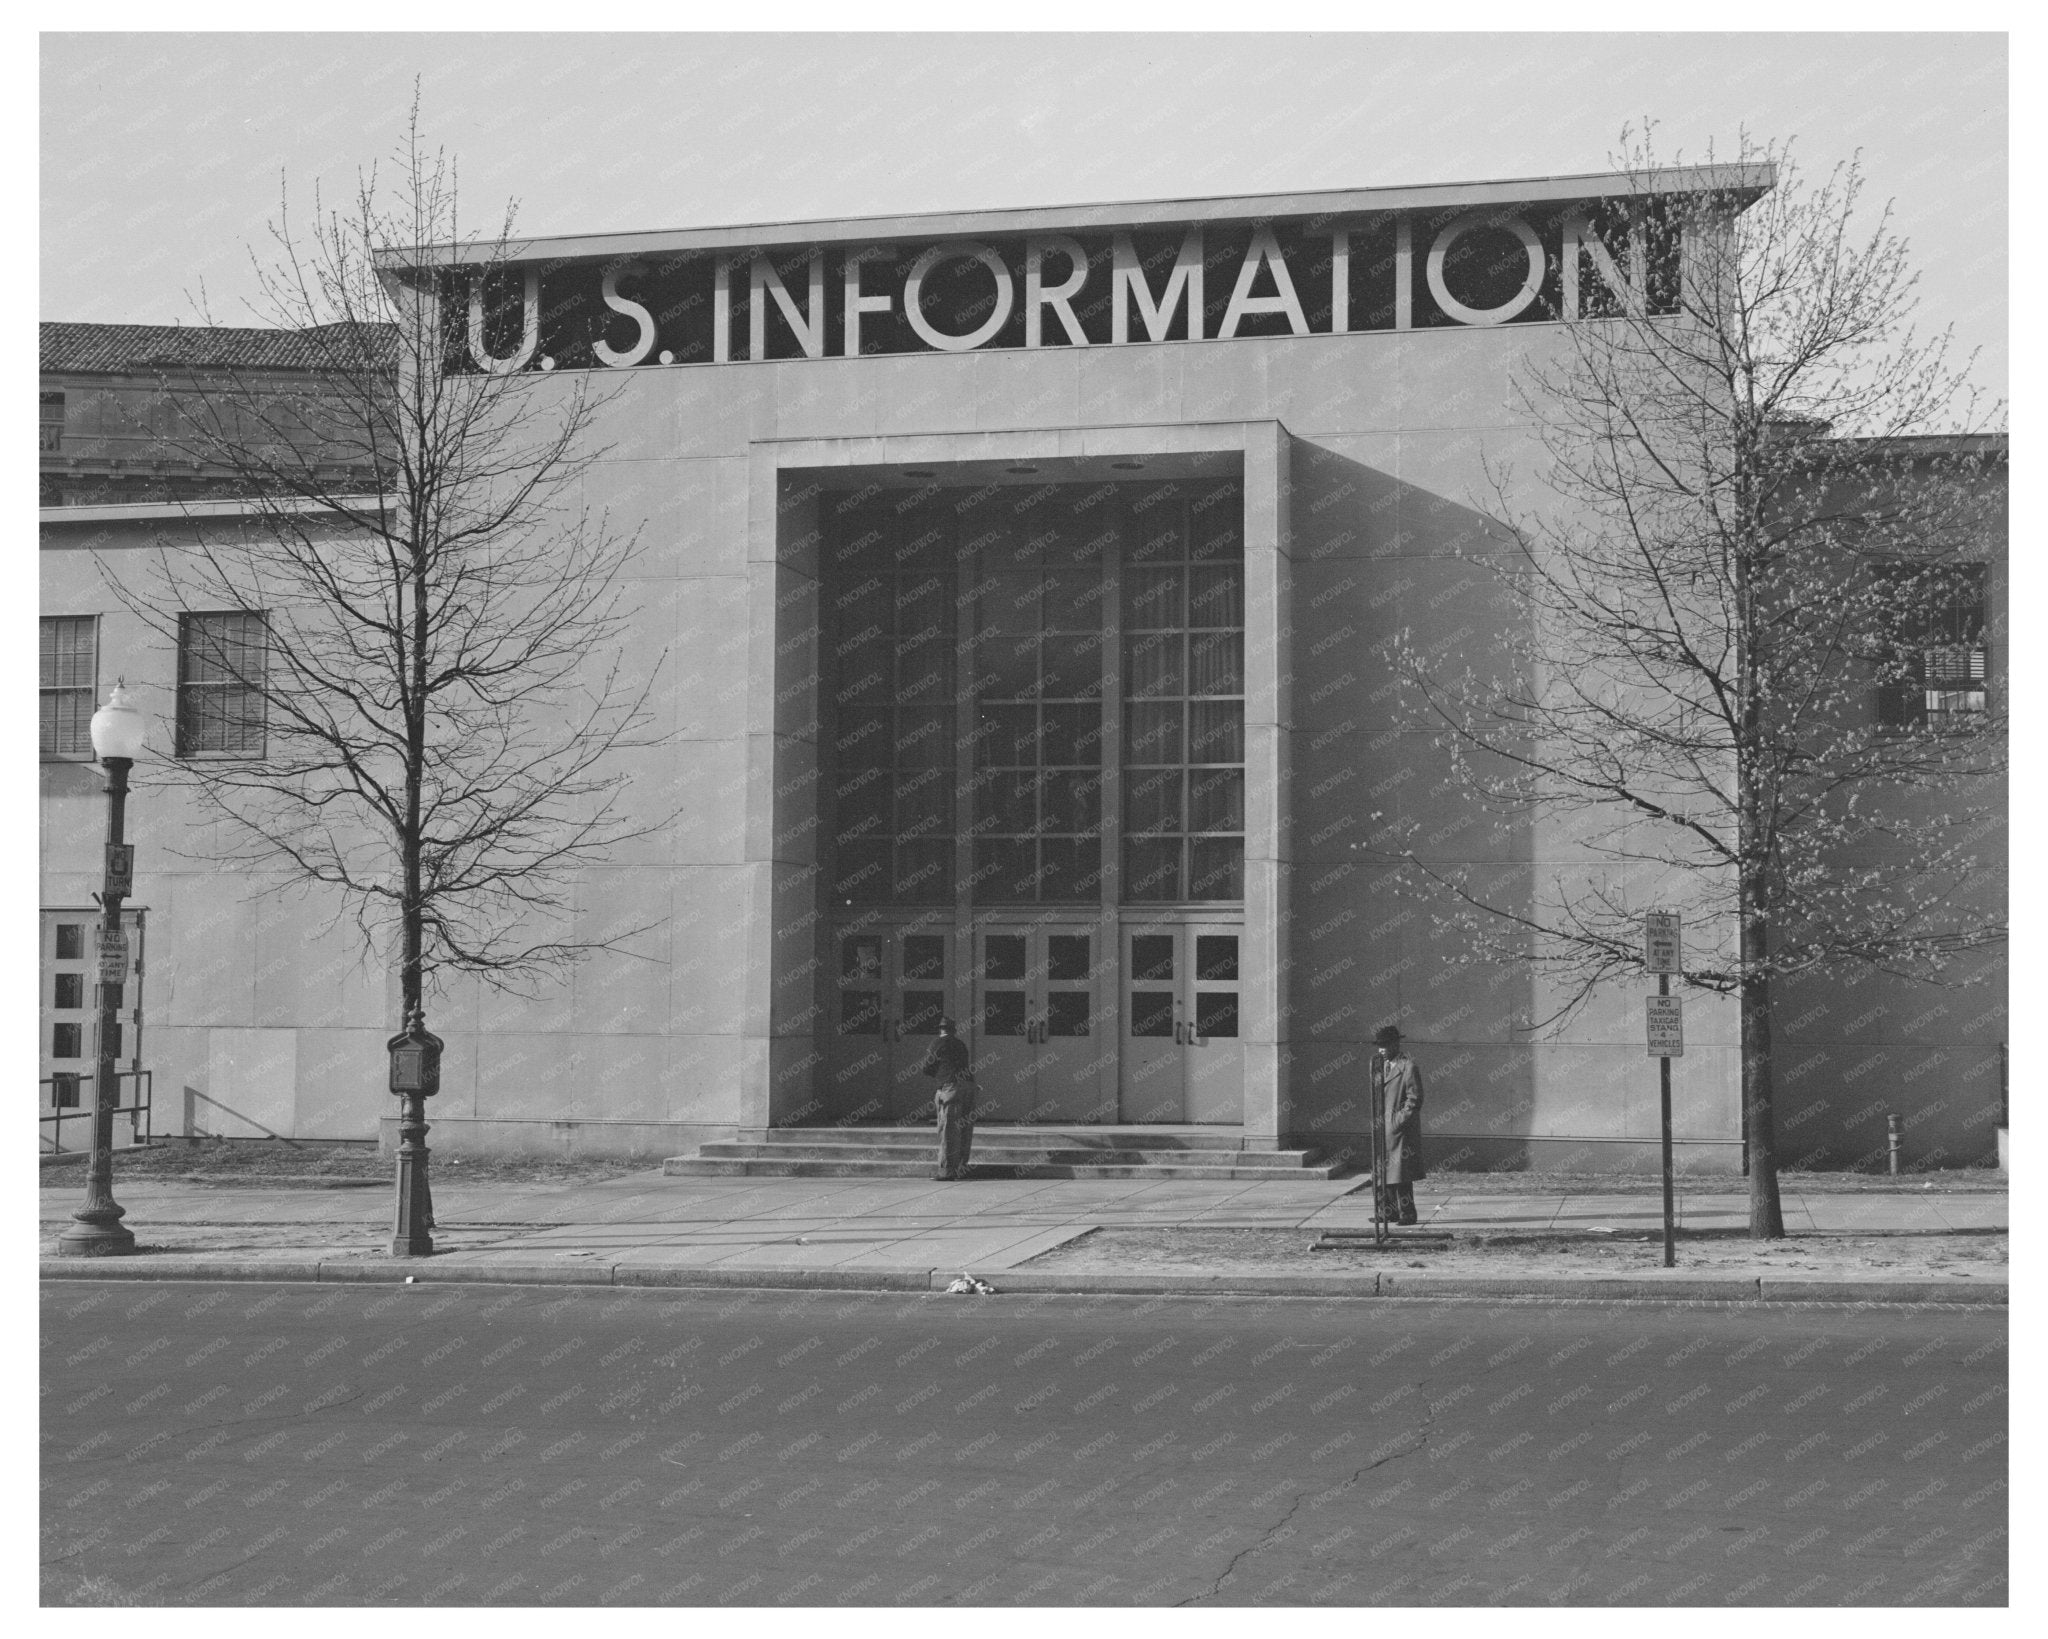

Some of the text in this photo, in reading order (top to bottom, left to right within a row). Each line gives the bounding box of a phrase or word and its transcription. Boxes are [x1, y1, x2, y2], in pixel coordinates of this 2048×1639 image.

[591, 260, 674, 369] S.
[713, 210, 1647, 364] INFORMATION
[108, 876, 131, 887] TURN
[1656, 917, 1671, 927] NO
[104, 934, 120, 943] NO
[100, 969, 122, 977] TIME
[1657, 999, 1671, 1007] NO
[1649, 1008, 1679, 1016] PARKING
[1650, 1024, 1679, 1032] STAND
[1649, 1039, 1680, 1048] VEHICLES
